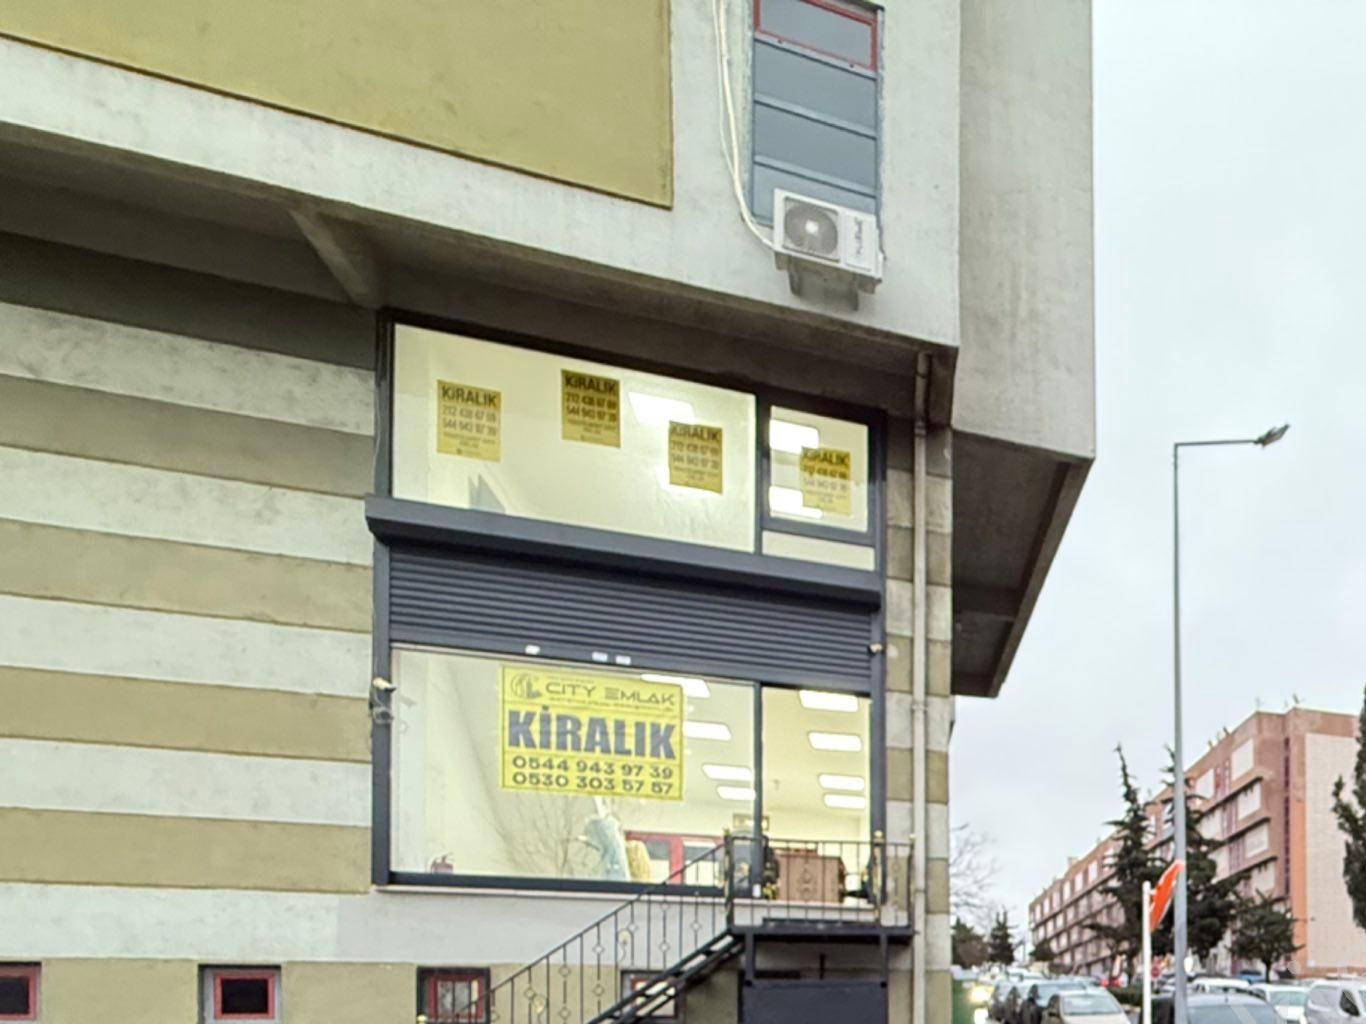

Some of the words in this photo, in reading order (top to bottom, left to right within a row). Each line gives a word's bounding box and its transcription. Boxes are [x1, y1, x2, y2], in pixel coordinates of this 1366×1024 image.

[508, 704, 677, 761] KİRALIK
[512, 755, 570, 772] 0544
[576, 760, 616, 776] 943
[621, 764, 645, 778] 97
[650, 766, 673, 780] 39
[512, 771, 569, 788] 0530
[576, 775, 616, 791] 303
[622, 779, 645, 793] 57
[650, 782, 674, 796] 57
